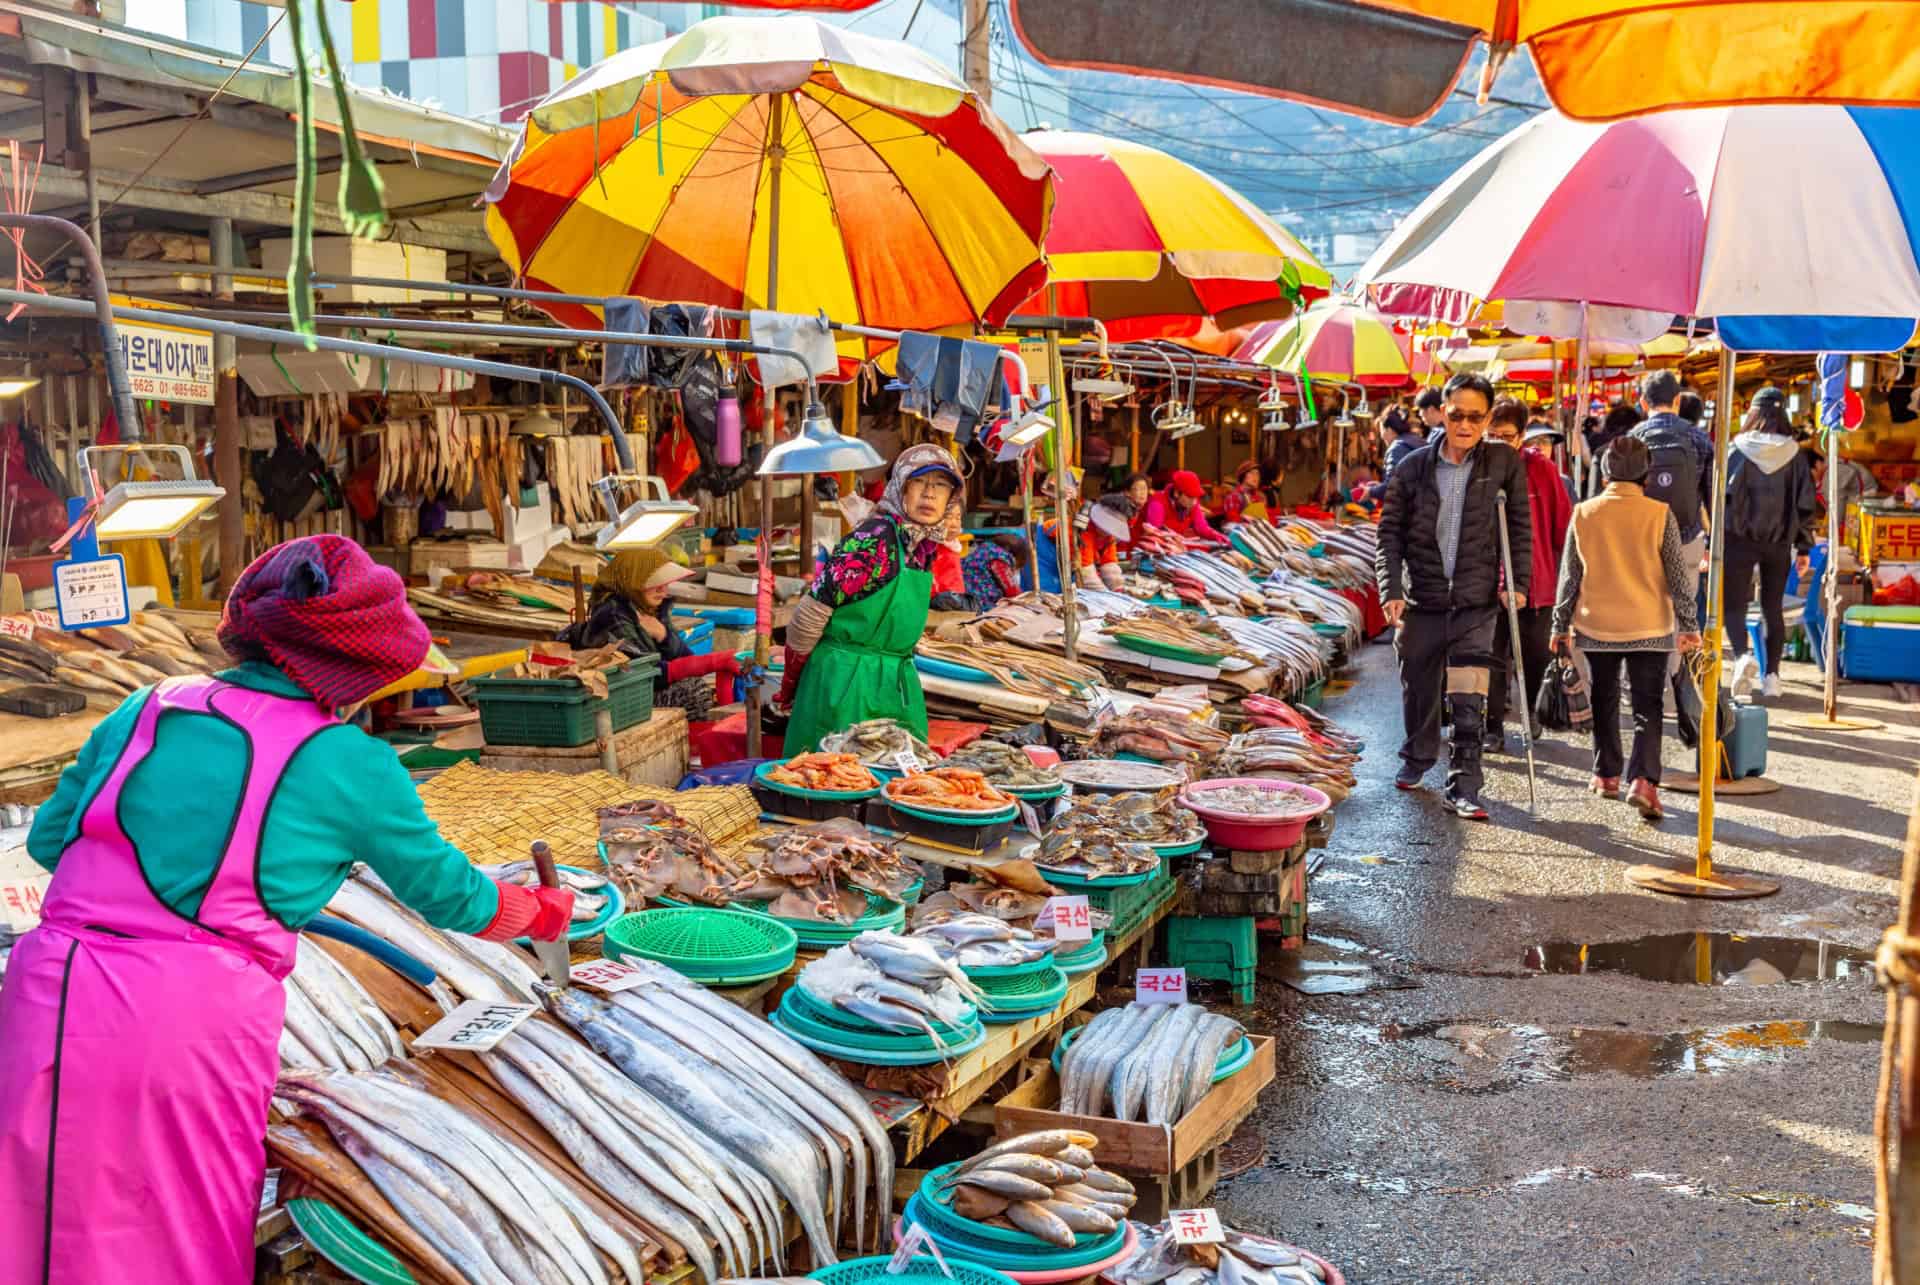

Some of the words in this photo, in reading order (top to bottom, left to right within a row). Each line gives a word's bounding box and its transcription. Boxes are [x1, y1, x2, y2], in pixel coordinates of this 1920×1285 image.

[1055, 905, 1088, 928] 국산
[1139, 975, 1182, 992] 국산
[1177, 1212, 1209, 1238] 국산
